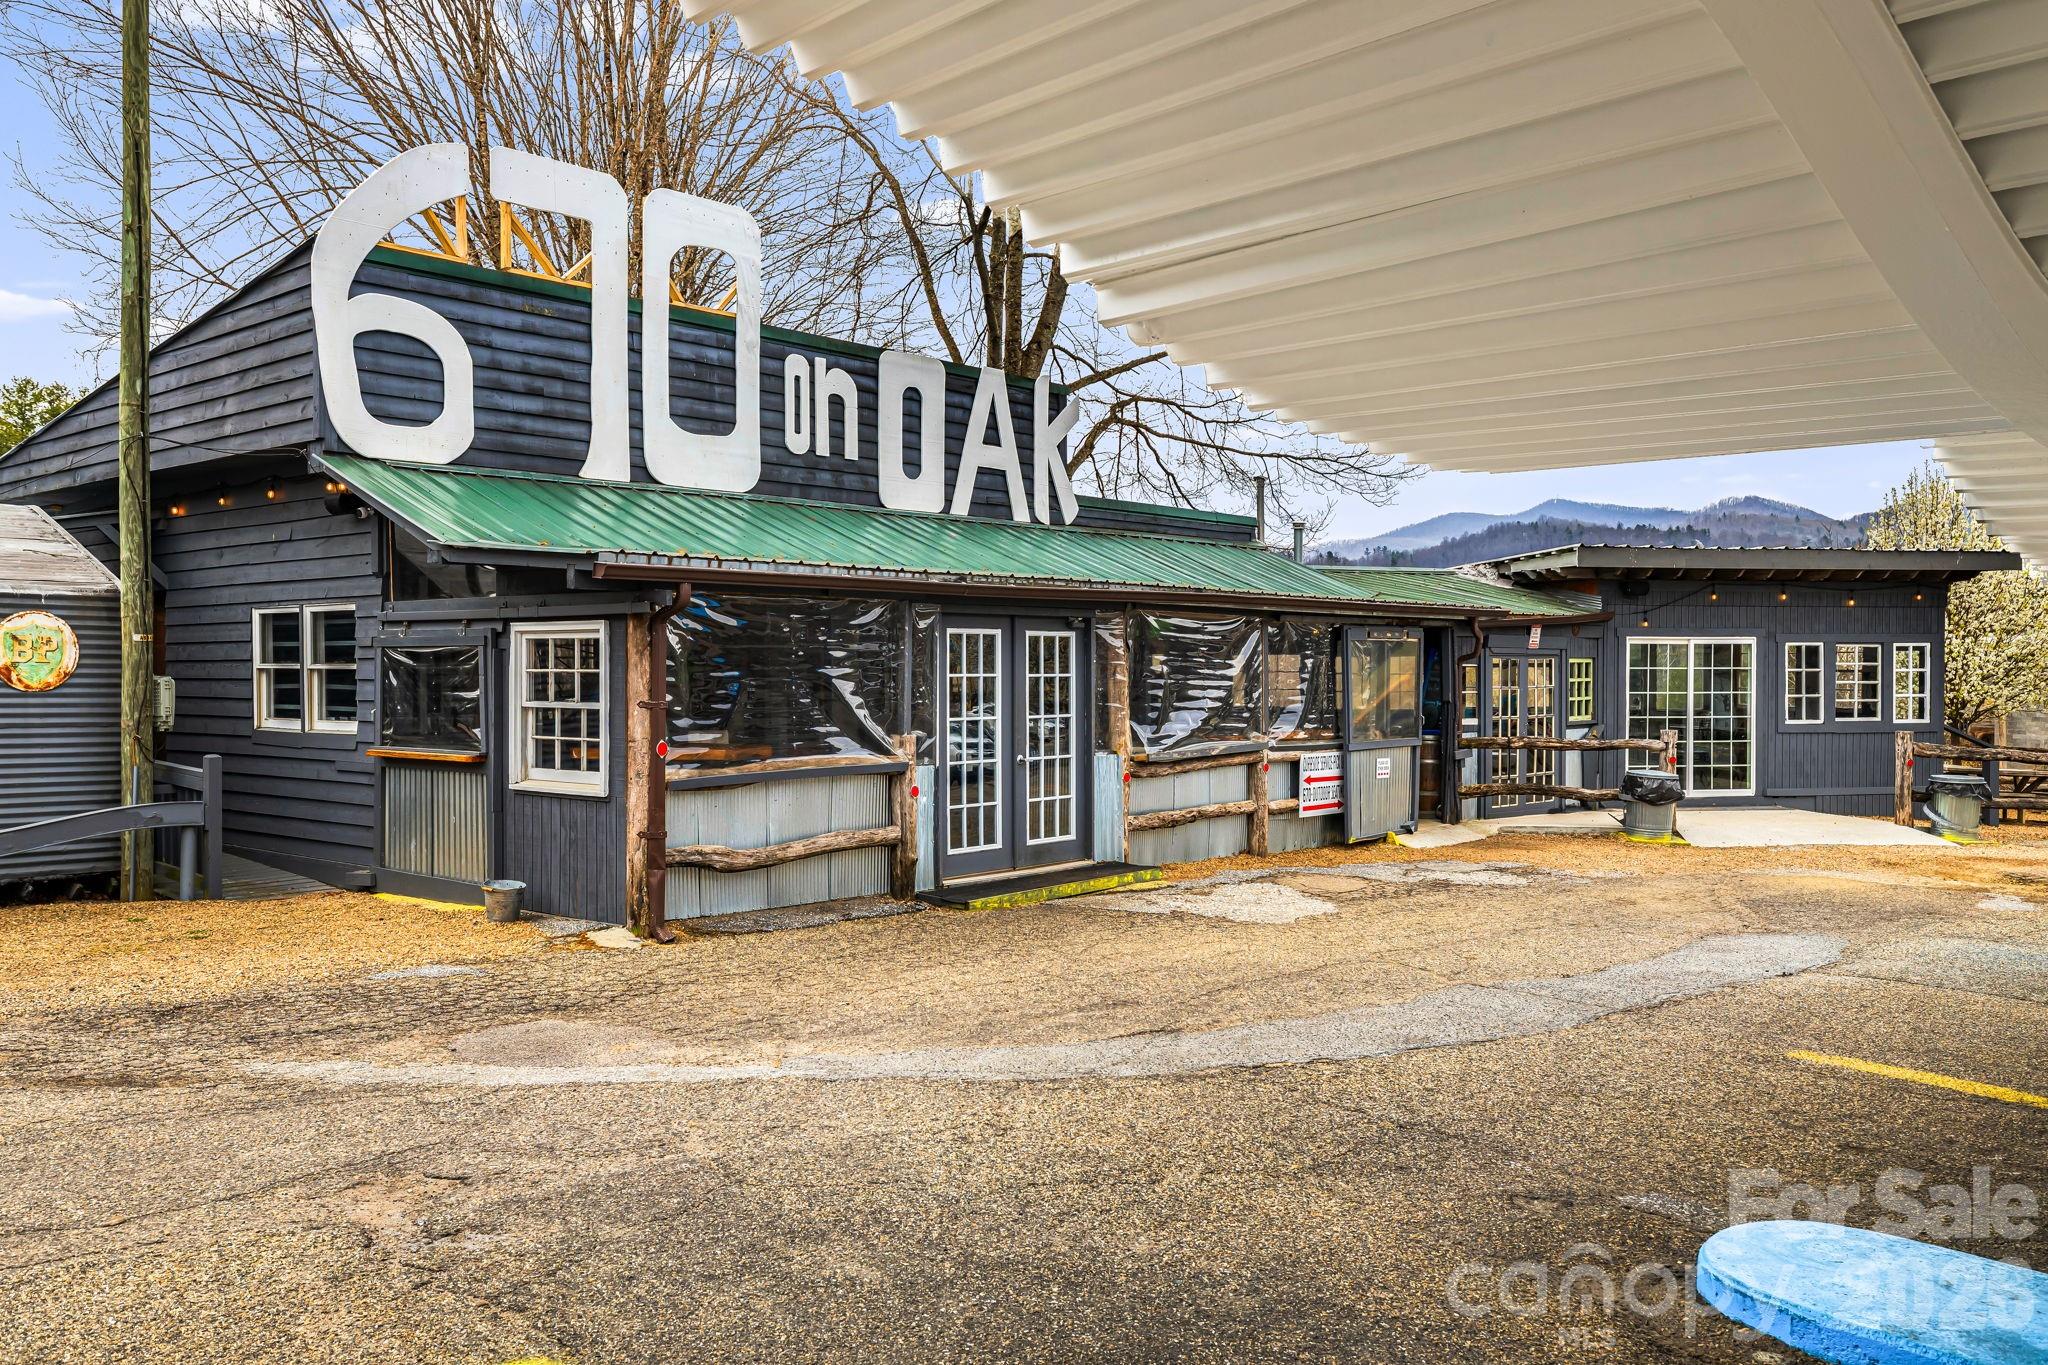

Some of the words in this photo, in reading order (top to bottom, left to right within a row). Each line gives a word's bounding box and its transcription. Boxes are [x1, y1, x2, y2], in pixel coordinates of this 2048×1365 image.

[311, 143, 761, 492] 670
[784, 353, 859, 460] on
[878, 349, 1080, 524] OAK
